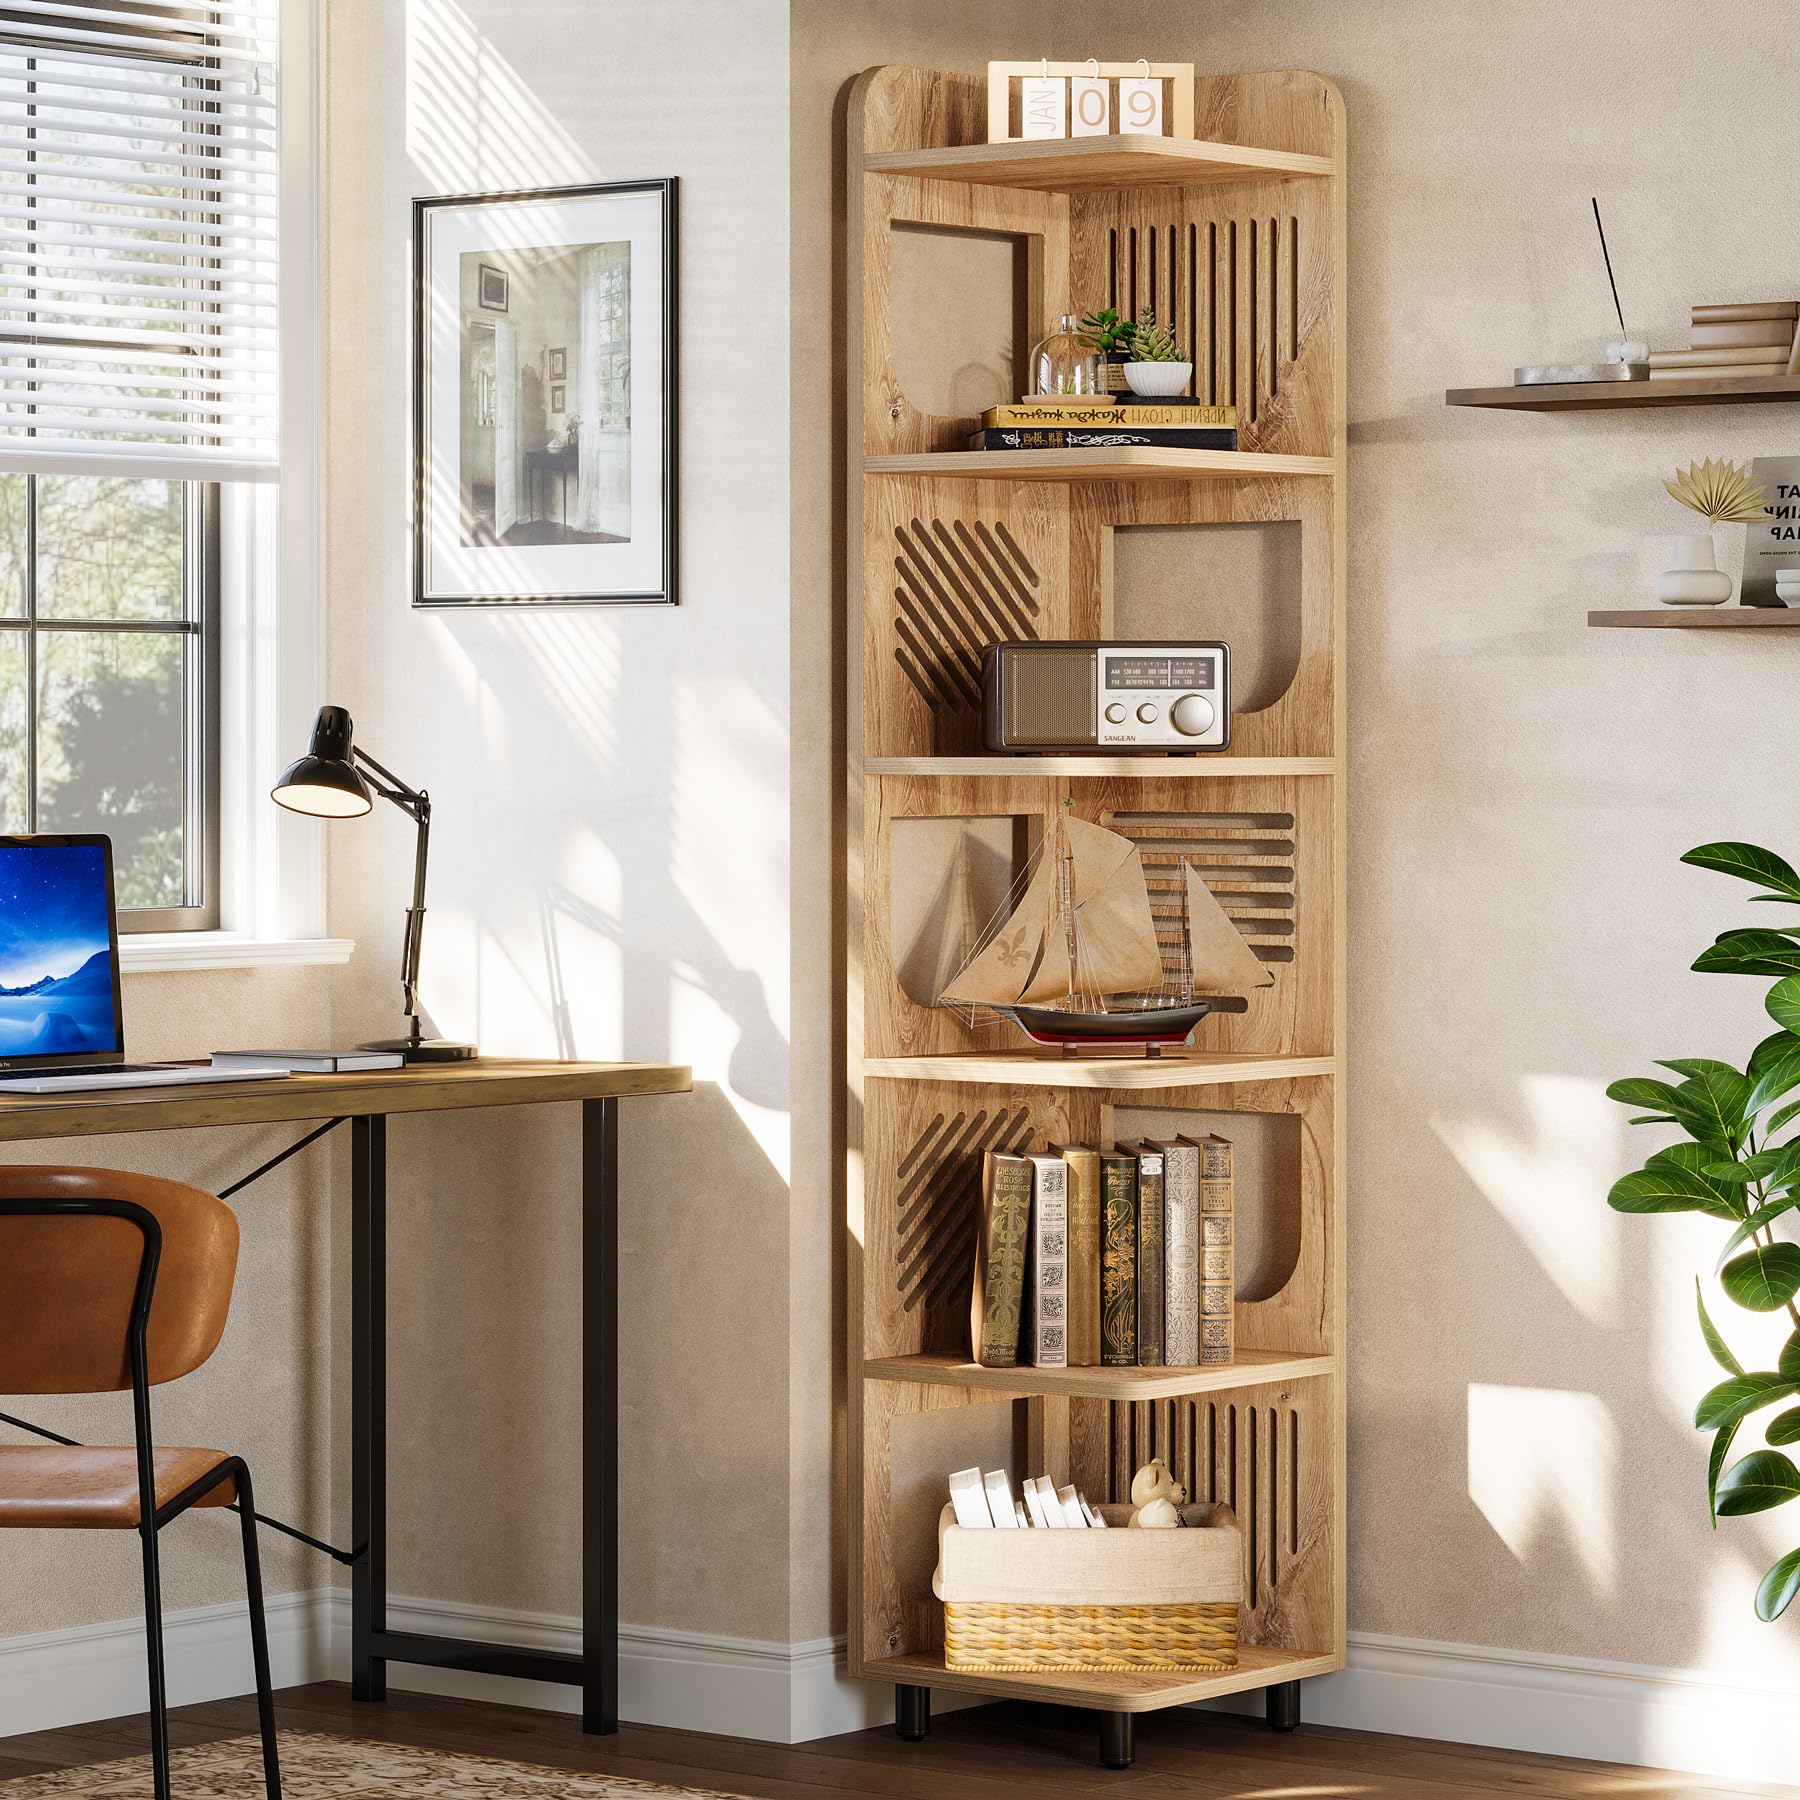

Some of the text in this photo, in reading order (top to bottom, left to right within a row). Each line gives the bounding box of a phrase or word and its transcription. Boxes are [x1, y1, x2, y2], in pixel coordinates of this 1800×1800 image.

[1029, 90, 1056, 132] JAN
[1131, 409, 1173, 424] СТОУН
[1177, 409, 1226, 424] ИРВИНГ
